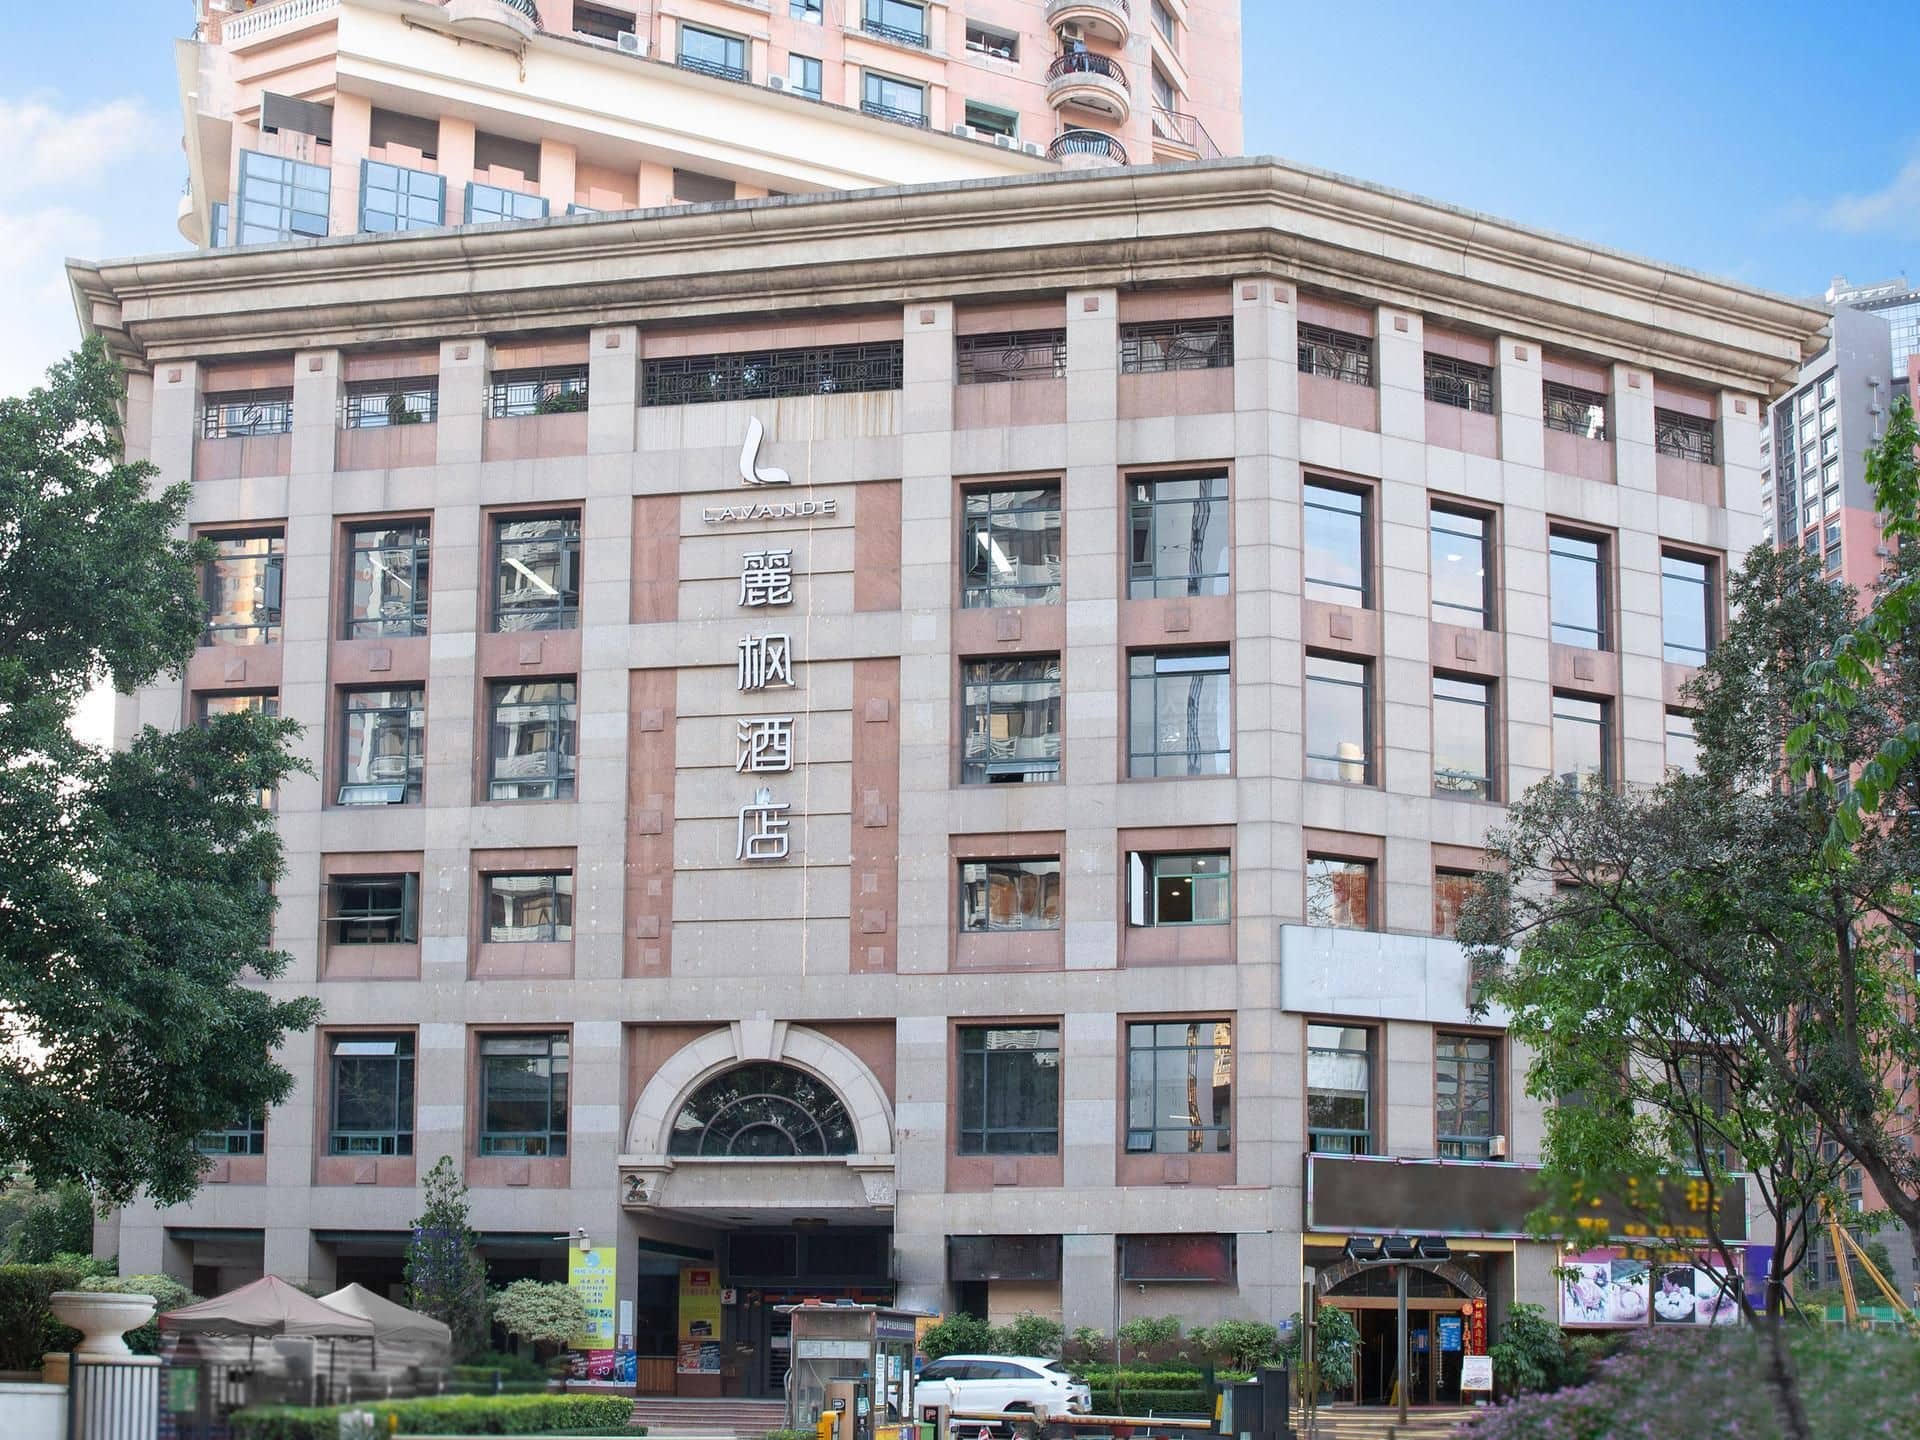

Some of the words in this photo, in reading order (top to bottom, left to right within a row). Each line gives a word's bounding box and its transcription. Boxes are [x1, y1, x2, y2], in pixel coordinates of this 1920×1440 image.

[702, 498, 838, 524] LAVANDE
[735, 548, 797, 862] 麗枫酒店
